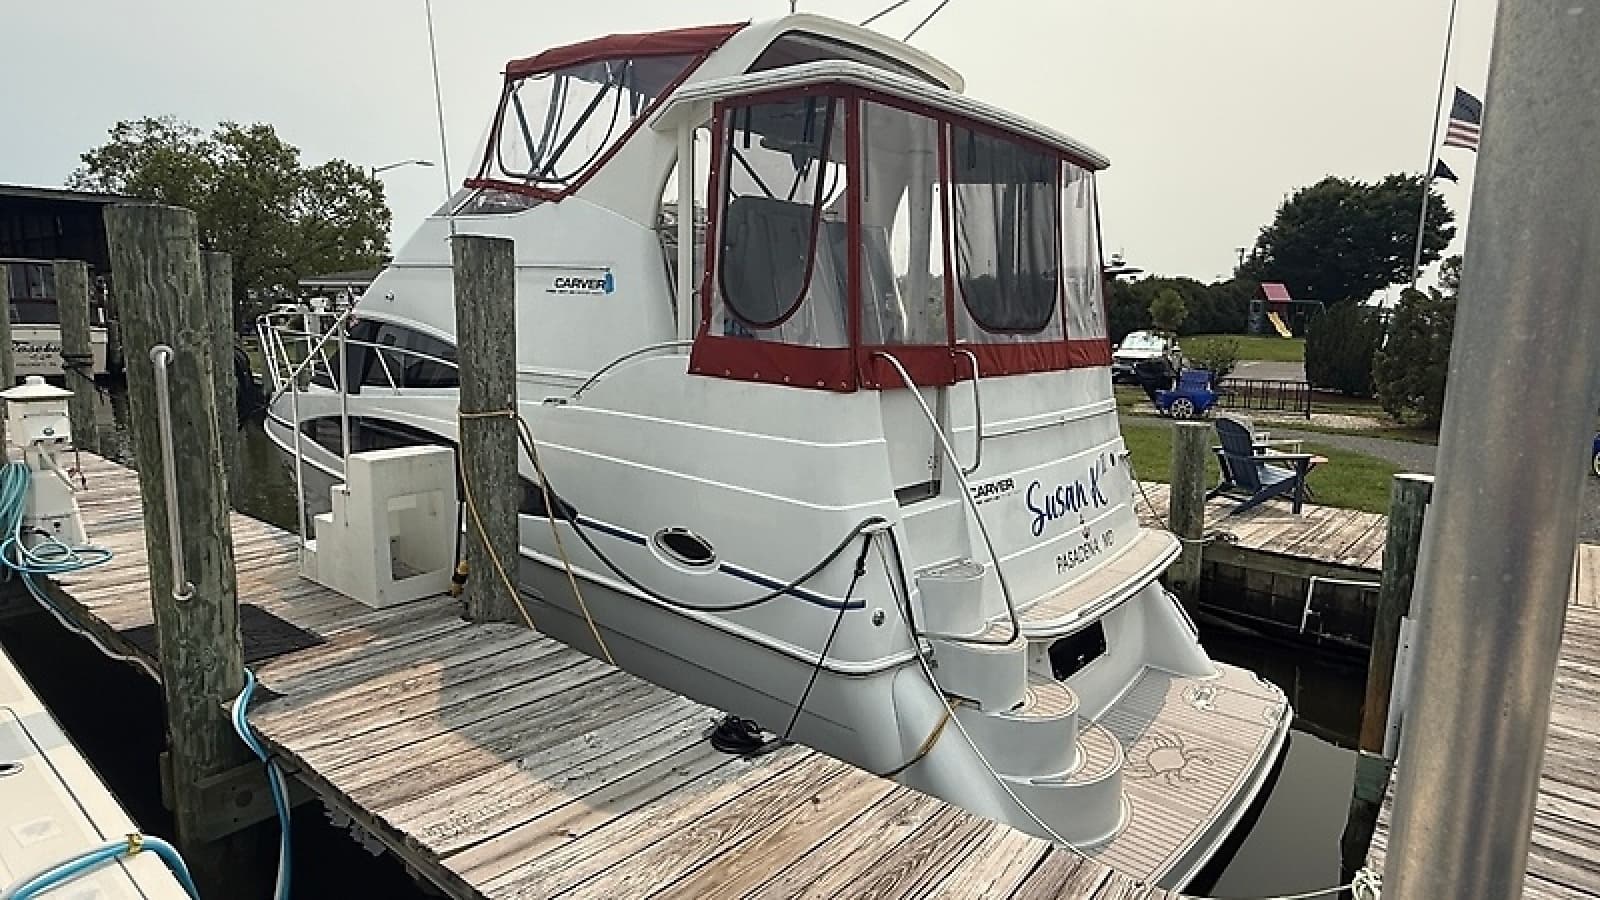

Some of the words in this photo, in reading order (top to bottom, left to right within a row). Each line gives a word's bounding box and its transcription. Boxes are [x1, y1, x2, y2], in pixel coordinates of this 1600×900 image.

[555, 277, 605, 289] CARVER
[969, 478, 1015, 498] CARVER
[1026, 479, 1089, 537] Susan
[1056, 538, 1102, 574] PASADENA
